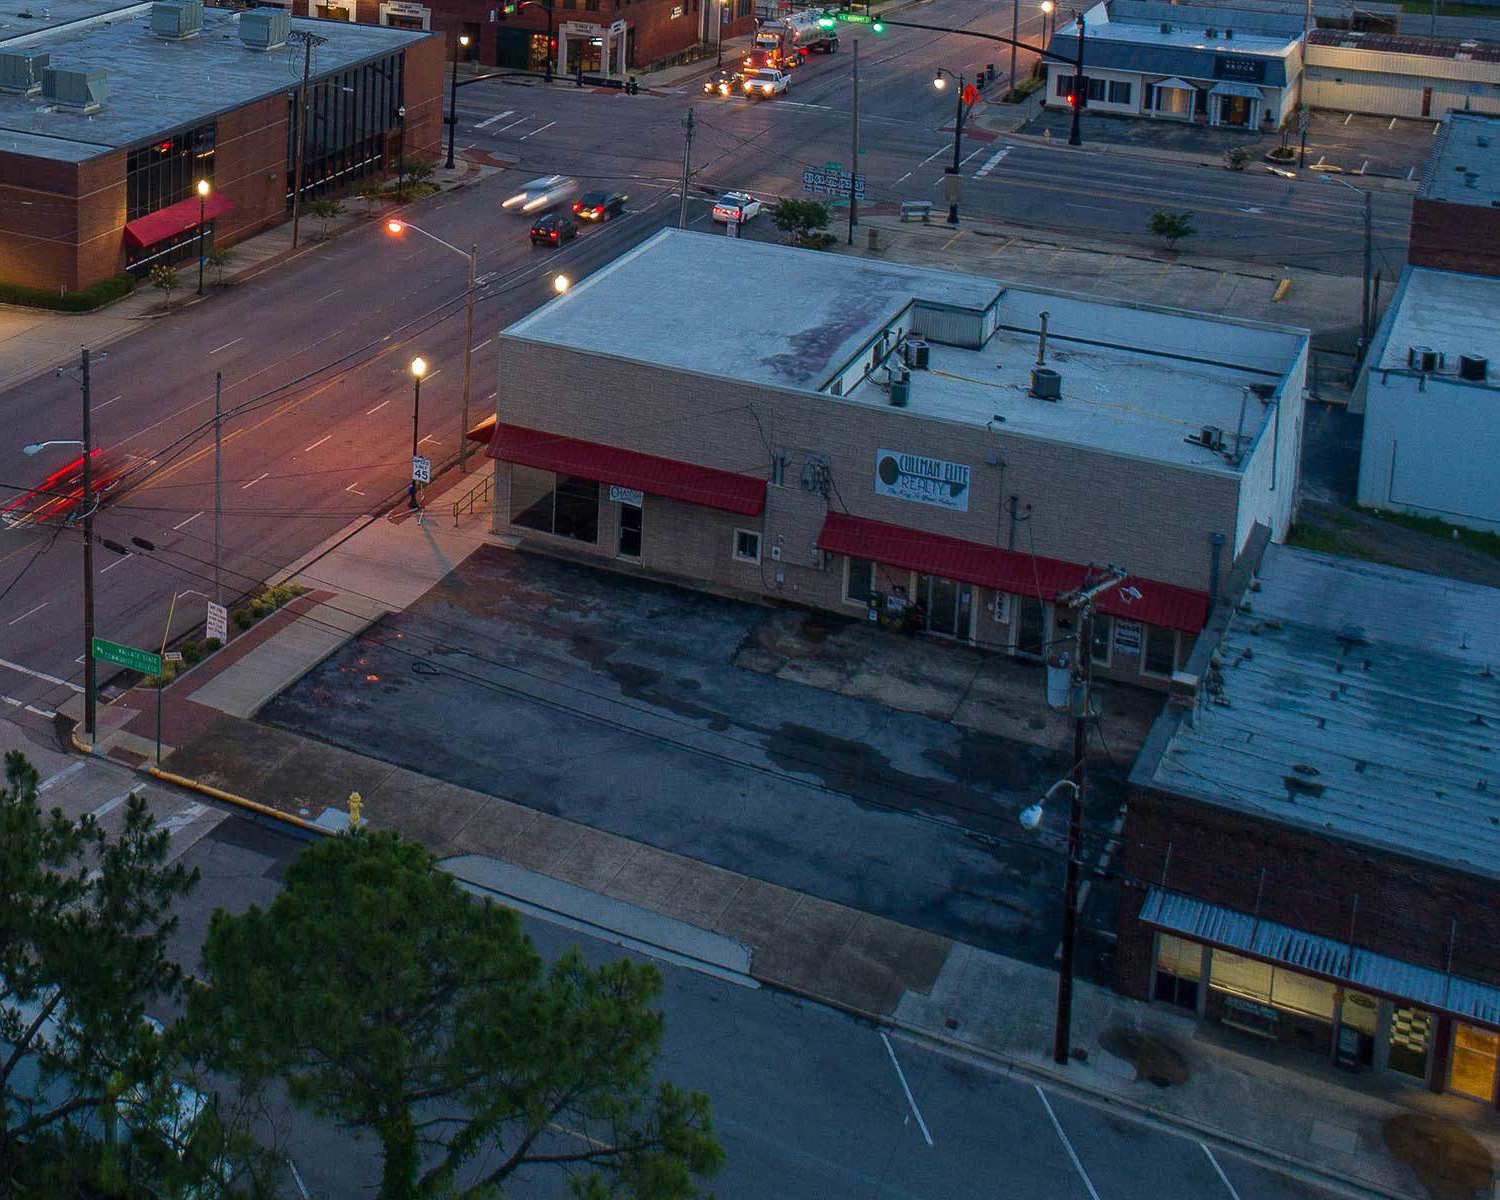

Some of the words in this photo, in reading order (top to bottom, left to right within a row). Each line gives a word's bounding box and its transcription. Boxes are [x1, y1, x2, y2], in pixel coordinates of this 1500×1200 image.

[415, 470, 428, 480] 45
[900, 455, 940, 478] CULLMAN
[945, 463, 969, 483] ELITE
[901, 474, 945, 495] REALTY
[117, 648, 140, 659] WALLACE
[142, 654, 157, 665] STATE
